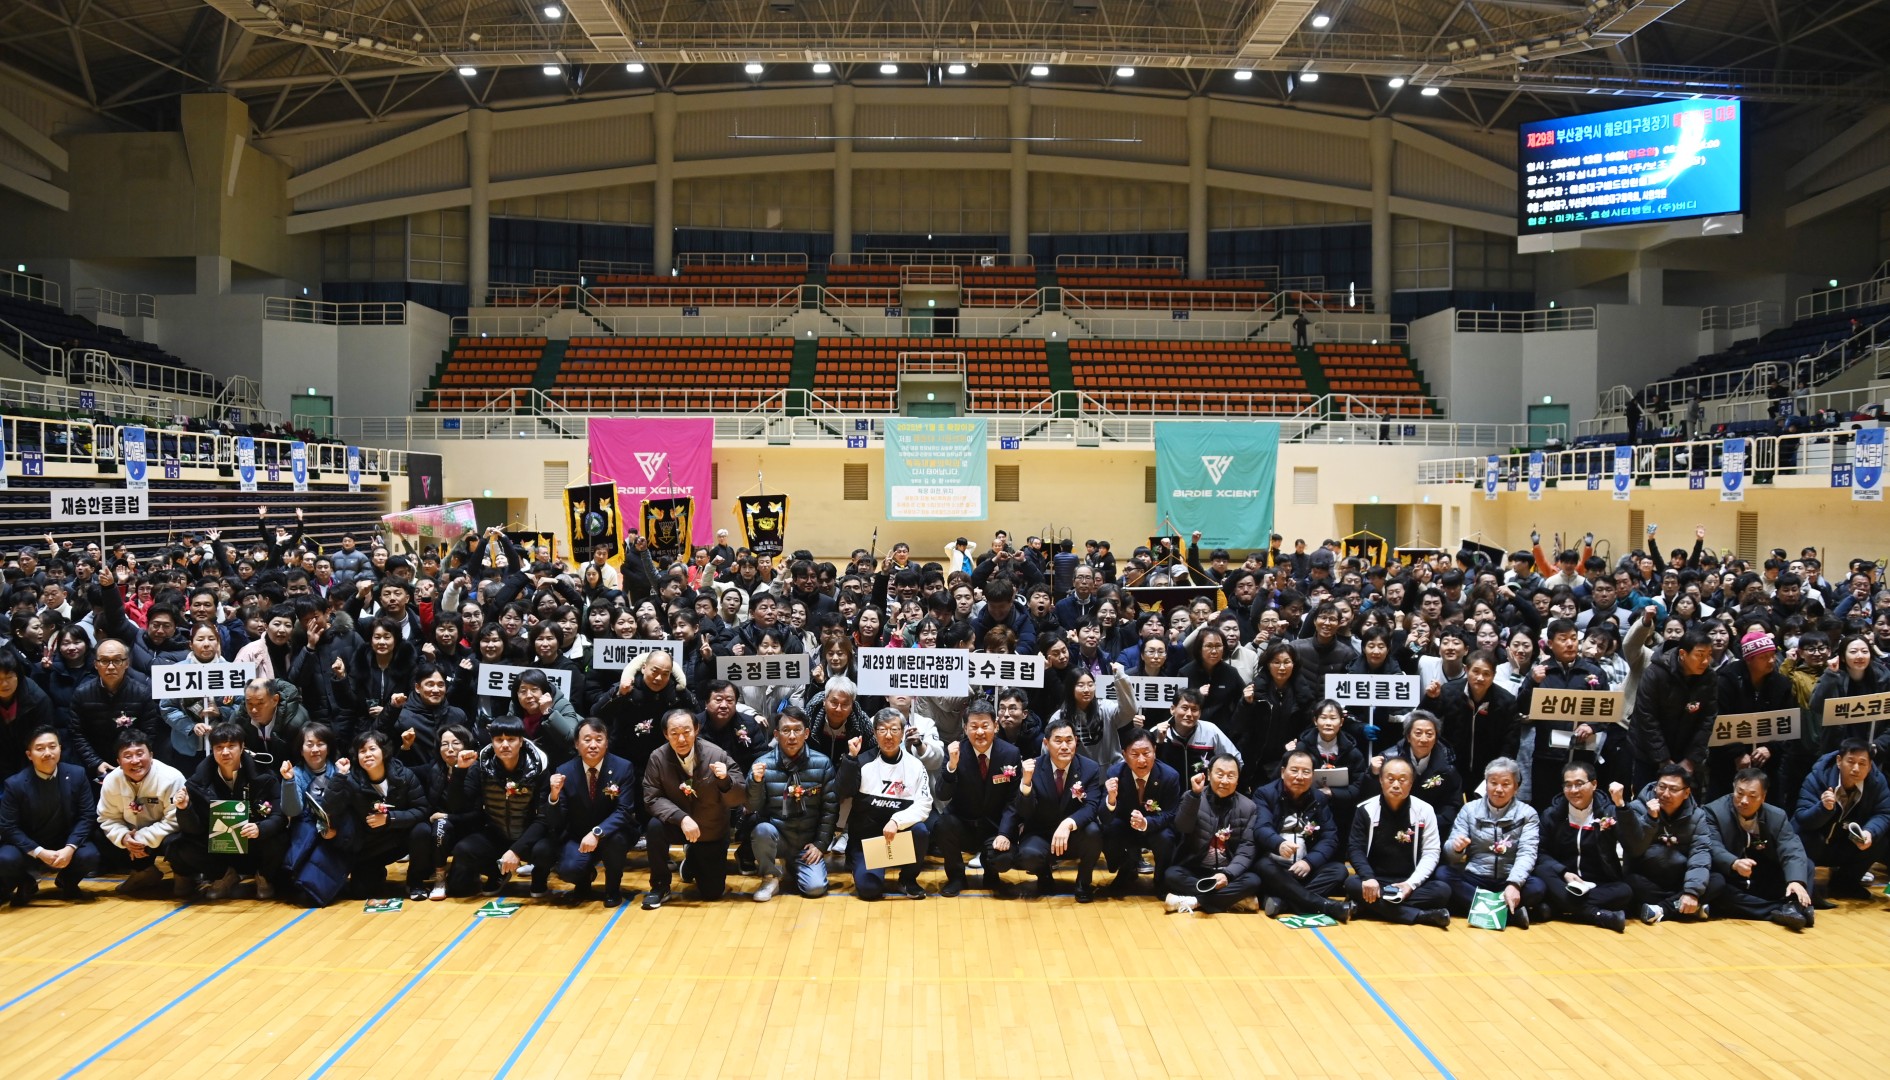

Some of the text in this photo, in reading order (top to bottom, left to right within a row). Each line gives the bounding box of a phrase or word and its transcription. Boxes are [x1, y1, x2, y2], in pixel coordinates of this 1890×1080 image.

[1527, 130, 1554, 148] 제29회
[1556, 124, 1602, 144] 부산광역시
[1604, 114, 1670, 138] 해운대구청장기
[81, 398, 93, 409] 2-5
[1002, 440, 1017, 449] 1-10
[25, 462, 40, 475] 1-4
[167, 467, 178, 478] 1-5
[1834, 473, 1850, 486] 1-15
[616, 486, 694, 494] RDIE XCIENT
[1172, 489, 1260, 498] BIRDIE XCIENT
[727, 660, 801, 681] 송정클럽
[862, 654, 964, 671] 제29회 해운대구청장기
[163, 669, 246, 692] 인지클럽
[889, 673, 949, 689] 배드민턴대회
[1105, 681, 1179, 702] 솔클럽
[1335, 680, 1410, 700] 센텀클럽
[1541, 695, 1615, 716] 삼어클럽
[1715, 715, 1792, 740] 삼솔클럽
[870, 798, 902, 809] MIKAZ
